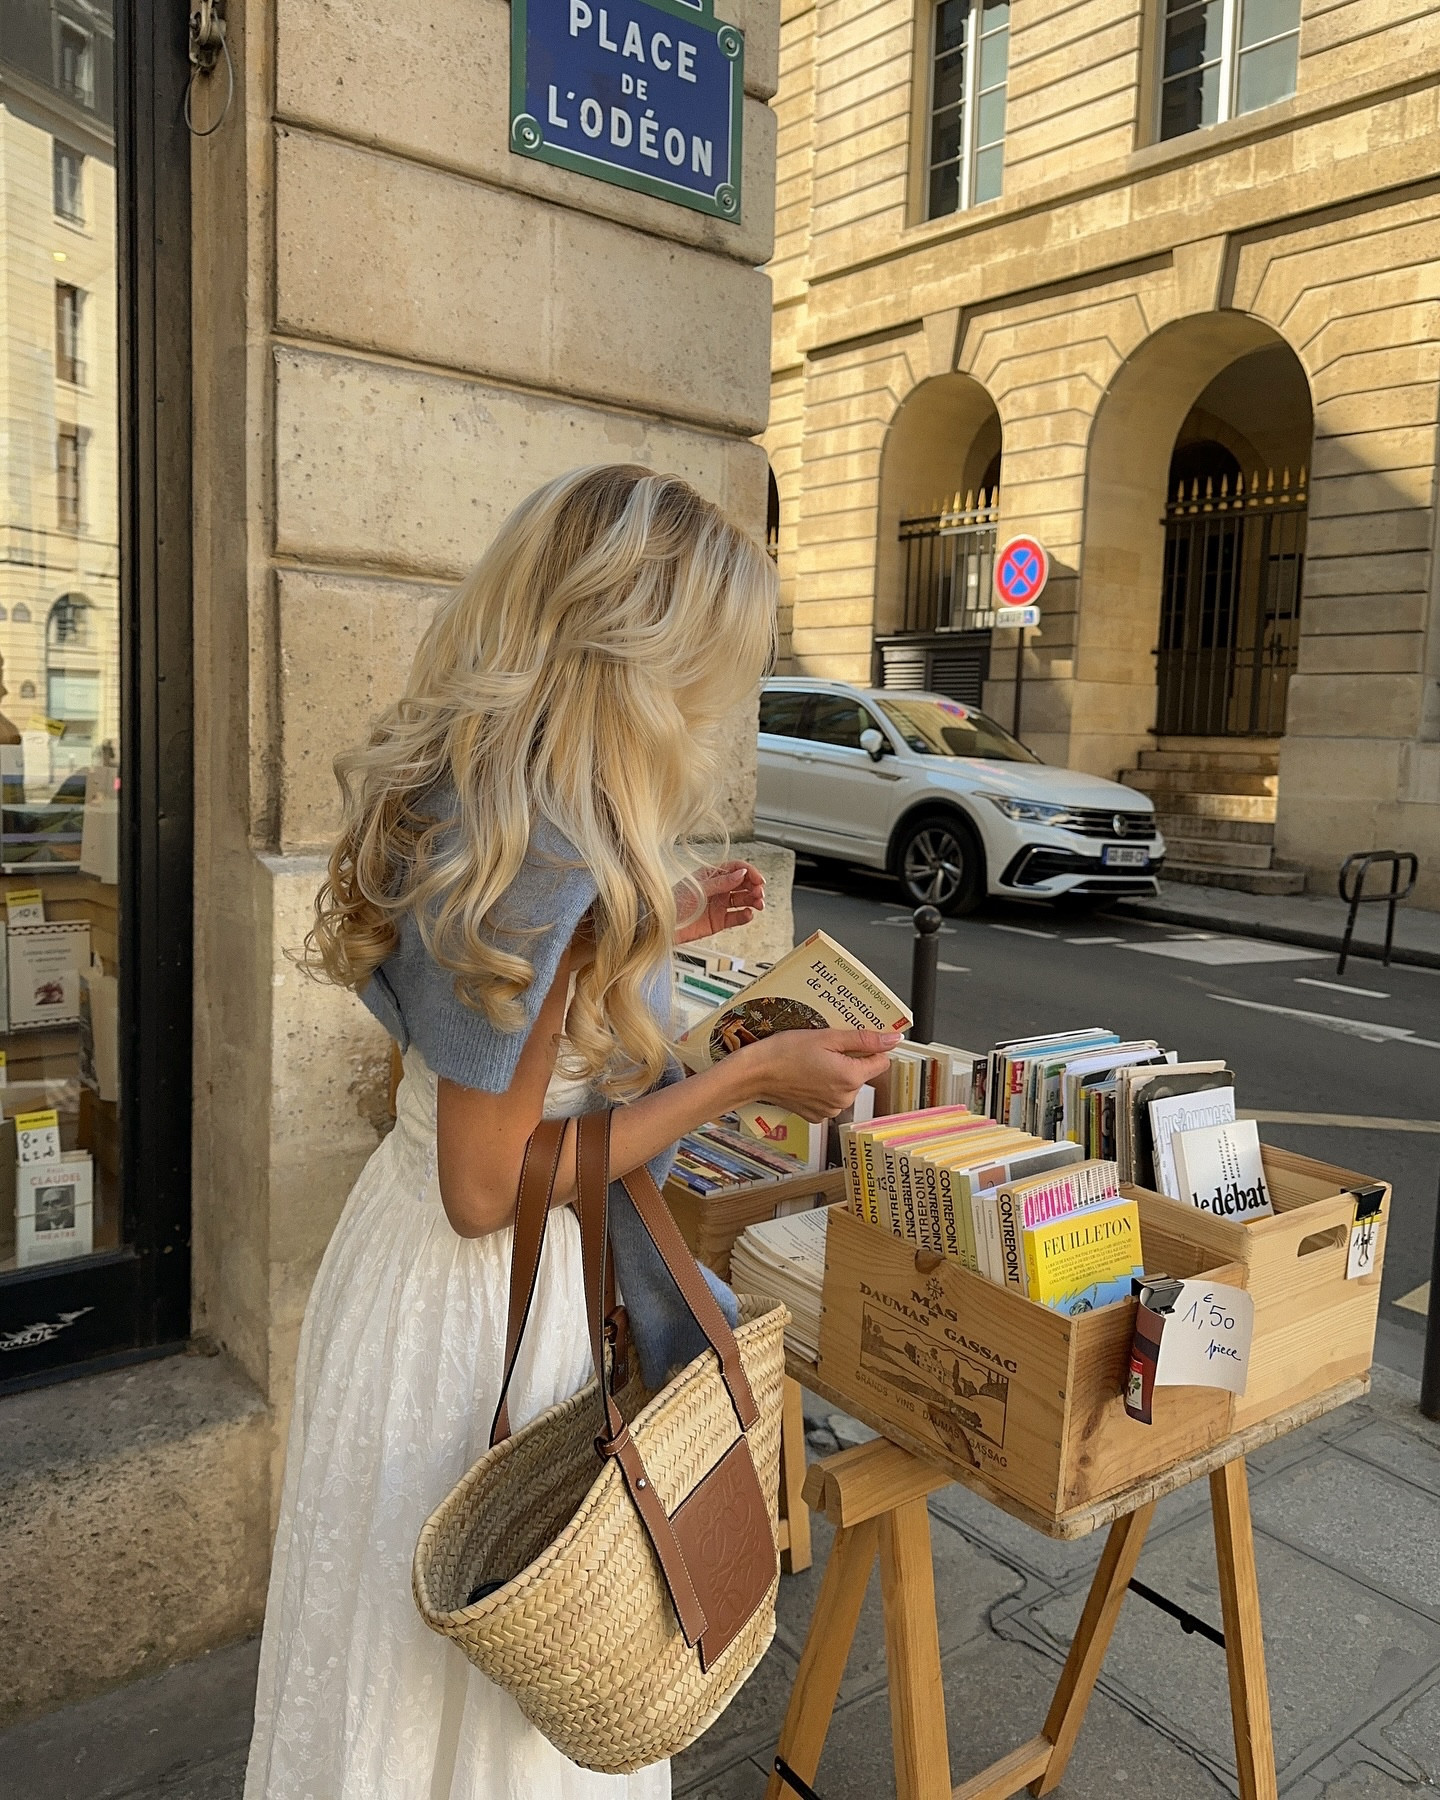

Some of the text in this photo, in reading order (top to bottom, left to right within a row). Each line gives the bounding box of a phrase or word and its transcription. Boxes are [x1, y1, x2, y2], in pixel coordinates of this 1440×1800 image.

[570, 0, 697, 83] PLACE
[621, 73, 648, 100] DE
[548, 85, 713, 177] L'ODÉON
[806, 977, 821, 991] de
[819, 989, 866, 1031] poétique
[810, 960, 886, 1031] Huit questions
[834, 957, 891, 1010] Roman Jakobson
[849, 1140, 864, 1219] NTREPOINT
[864, 1141, 879, 1224] ONTREPOINT
[885, 1153, 902, 1237] ONTREPOINT
[899, 1156, 917, 1240] CONTREPOINT
[914, 1168, 931, 1251] NTREPOINT
[925, 1168, 943, 1253] CONTREPOINT
[940, 1170, 958, 1255] CONTREPOINT
[1192, 1177, 1269, 1216] le débat
[1000, 1194, 1020, 1283] CONTREPOINT
[1043, 1216, 1132, 1258] FEUILLETON
[859, 1282, 1018, 1373] DAUMAS GASSAC
[910, 1290, 958, 1322] MAS
[855, 1370, 1008, 1468] GRANDS VINS DAUMAS GASSAC
